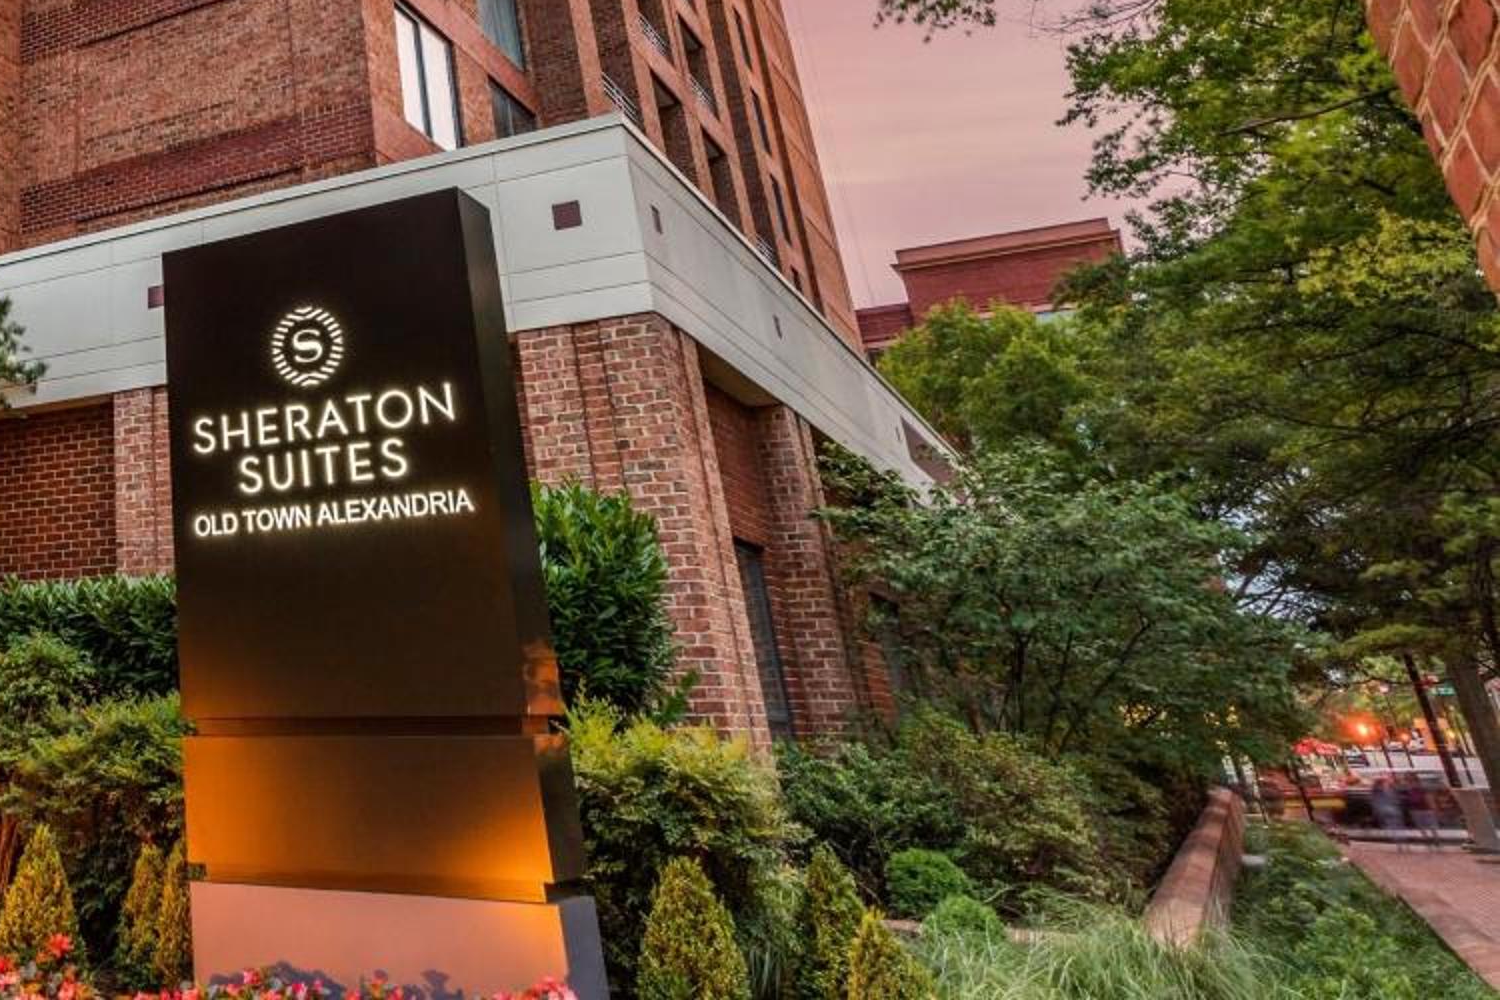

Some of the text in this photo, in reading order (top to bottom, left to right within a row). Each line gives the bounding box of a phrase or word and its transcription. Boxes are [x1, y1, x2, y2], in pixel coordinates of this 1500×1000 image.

[292, 329, 323, 363] S
[193, 382, 456, 454] SHERATON
[239, 438, 407, 494] SUITES
[194, 488, 475, 537] OLD TOWN ALEXANDRIA
